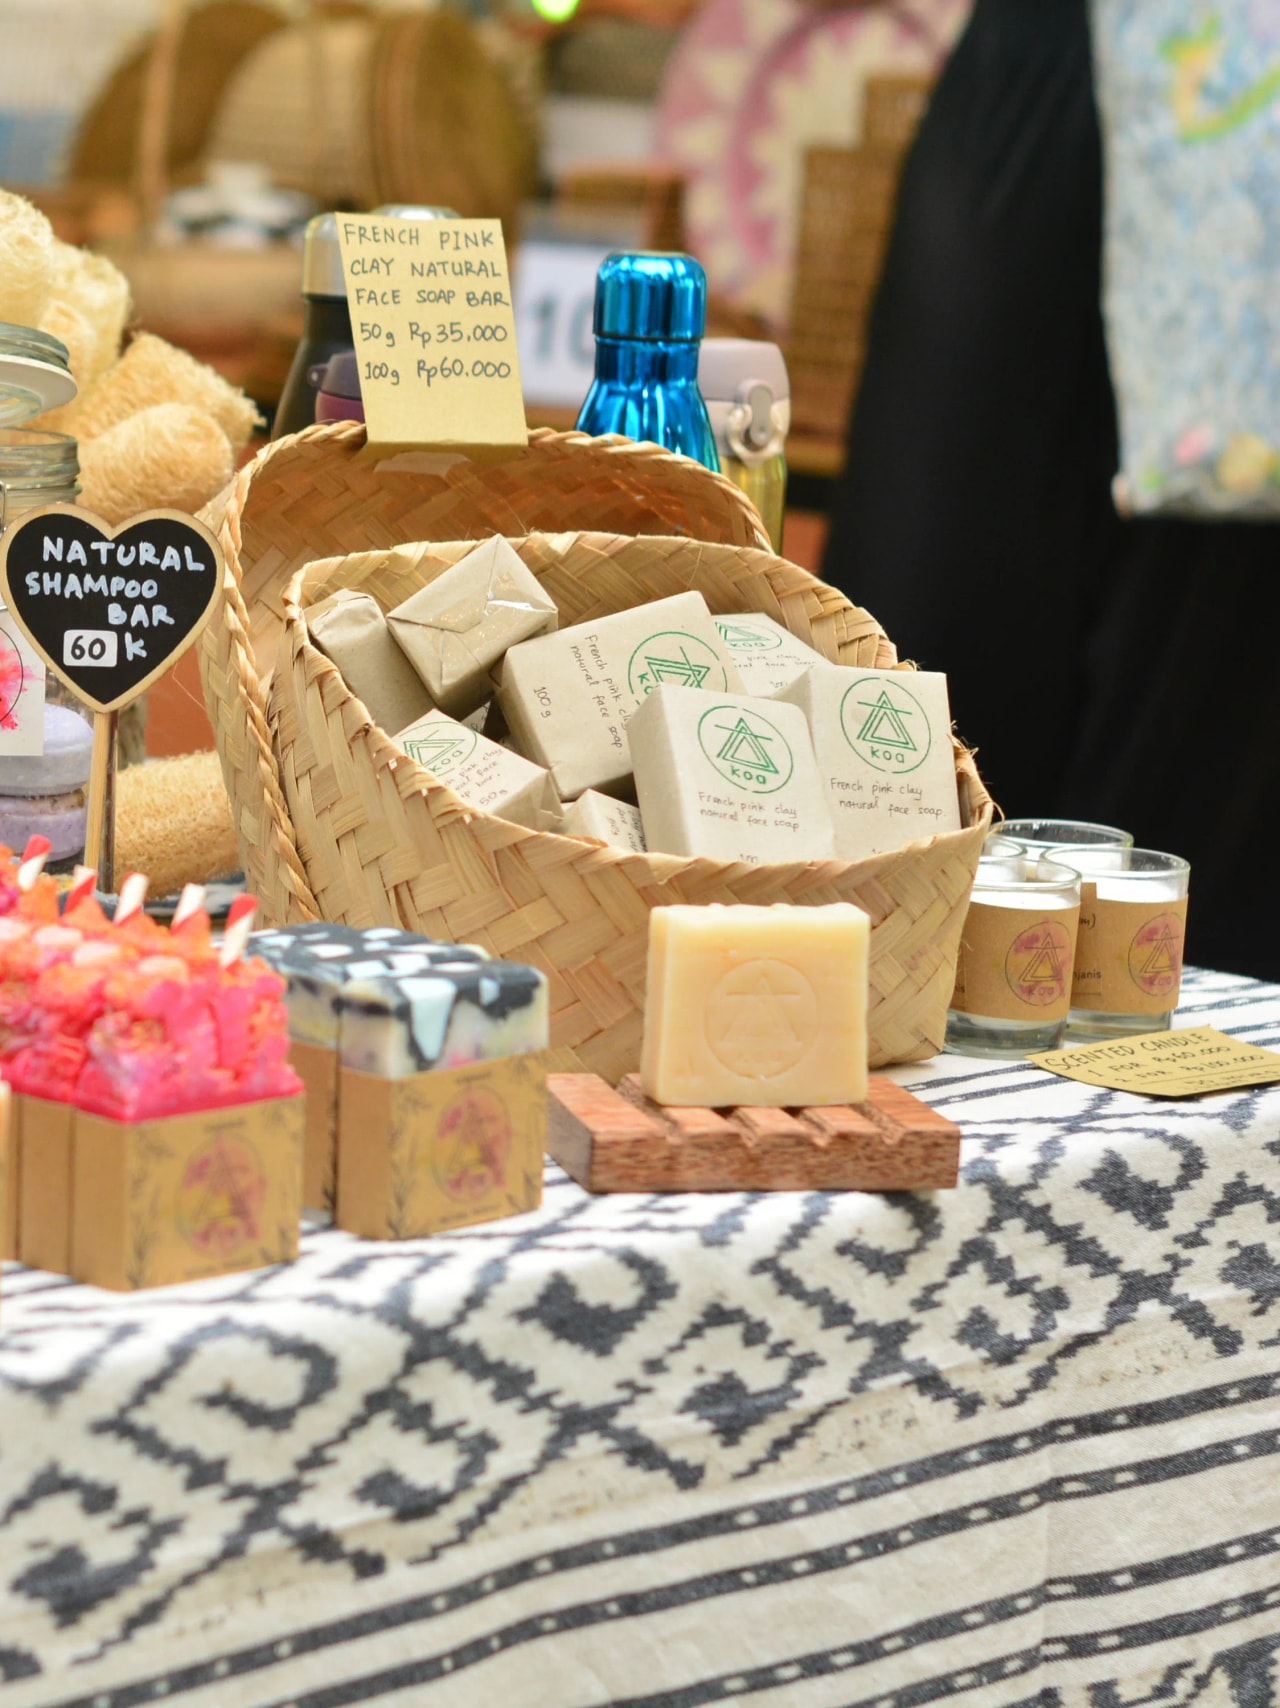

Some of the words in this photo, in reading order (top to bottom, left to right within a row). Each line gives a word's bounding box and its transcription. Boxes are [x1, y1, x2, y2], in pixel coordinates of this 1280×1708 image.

[344, 223, 420, 245] FRENCH
[439, 230, 495, 250] PINK
[350, 257, 395, 276] CLAY
[411, 260, 502, 278] NATURAL
[356, 288, 401, 306] FACE
[416, 289, 456, 305] SOAP
[466, 290, 510, 307] BAR
[42, 535, 205, 572] NATURAL
[25, 571, 158, 600] SHAMPOO
[107, 602, 175, 628] BAR
[70, 635, 107, 661] 60
[584, 634, 608, 671] French
[603, 677, 623, 702] pink
[570, 645, 599, 687] natural
[592, 695, 610, 719] face
[830, 777, 864, 792] French
[872, 781, 893, 796] pink
[899, 783, 923, 801] clay
[698, 791, 735, 807] French
[740, 801, 766, 813] pink
[775, 803, 798, 820] clay
[700, 808, 739, 822] natural
[747, 815, 769, 827] face
[839, 796, 879, 810] natural
[888, 804, 910, 818] face
[1045, 1045, 1135, 1071] SCENTED
[1140, 1033, 1210, 1052] CANDLE
[1108, 1062, 1145, 1072] FOR
[1136, 1070, 1173, 1079] FOR
